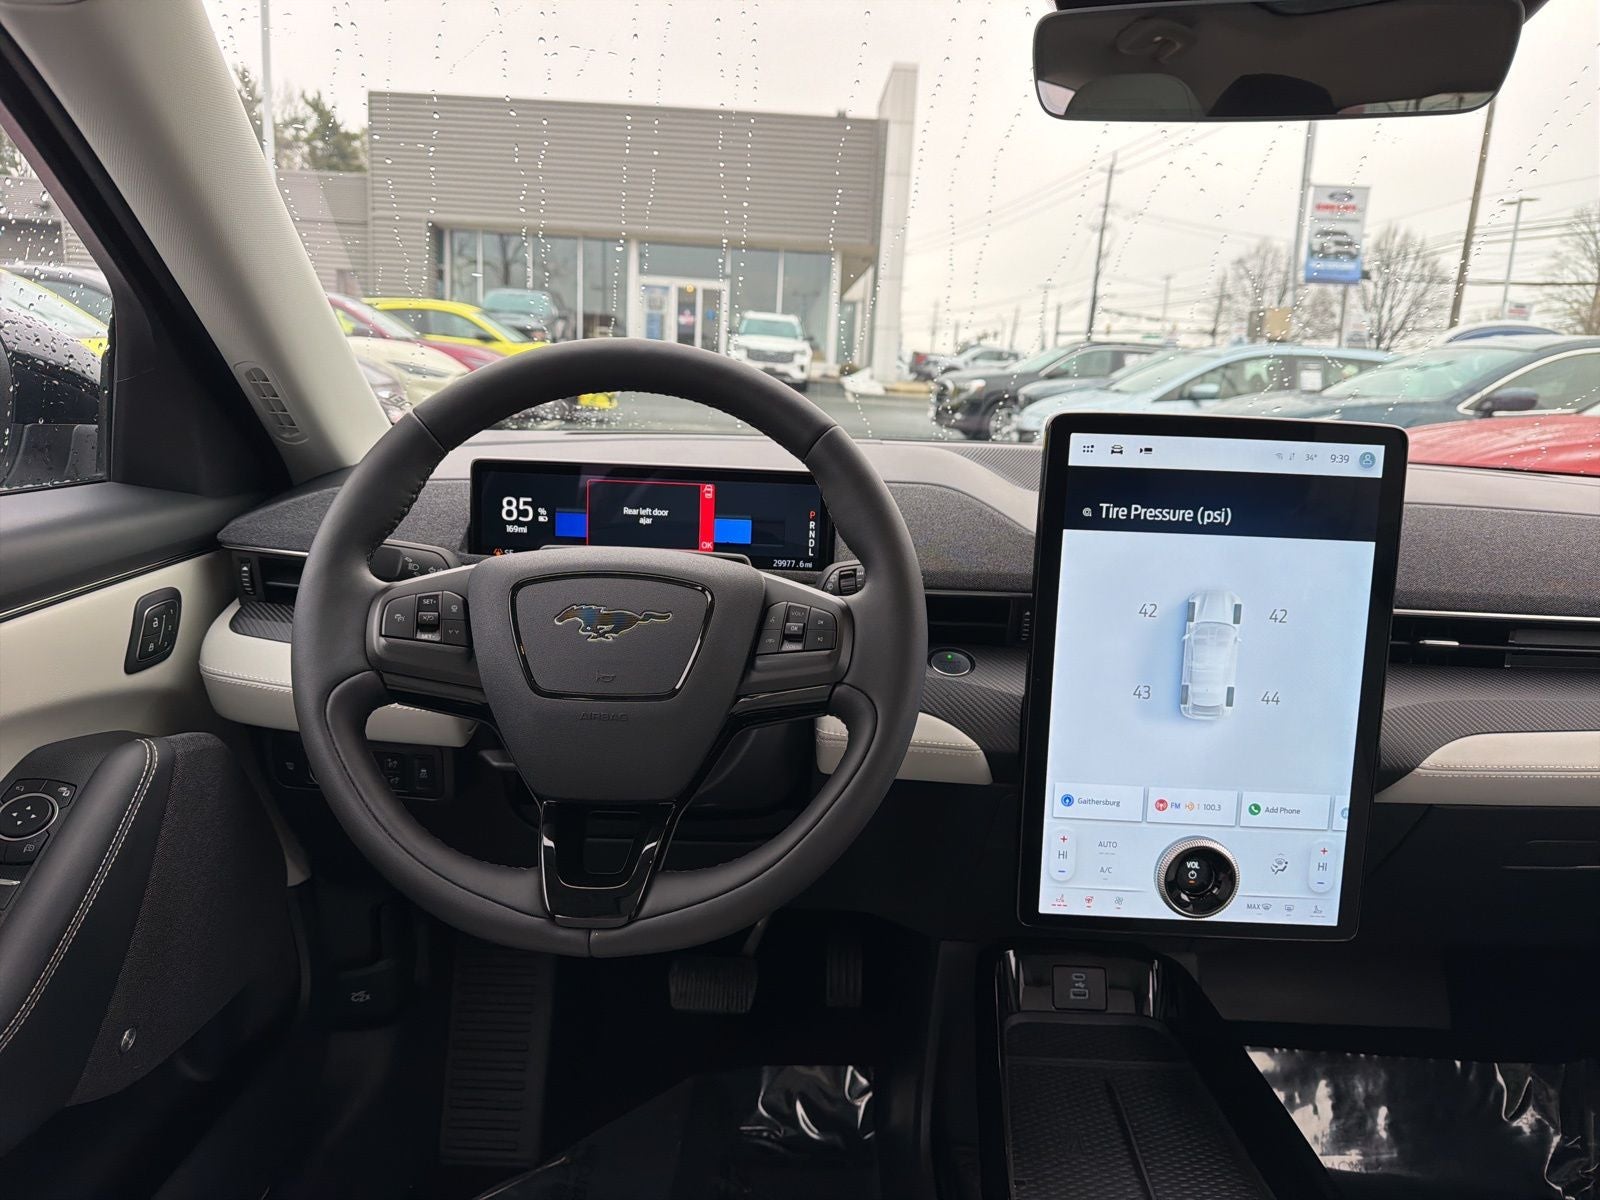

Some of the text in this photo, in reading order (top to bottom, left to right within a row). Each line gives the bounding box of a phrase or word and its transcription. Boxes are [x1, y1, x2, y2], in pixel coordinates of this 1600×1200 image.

[1330, 454, 1350, 464] 9:39
[502, 497, 534, 522] 85
[538, 507, 547, 515] %
[623, 507, 669, 516] Rear left door
[1100, 503, 1232, 526] Tire Pressure (psi)
[639, 517, 652, 525] ajar
[1138, 603, 1157, 618] 42
[1269, 609, 1288, 623] 42
[1133, 685, 1151, 699] 43
[1261, 691, 1280, 705] 44
[1077, 797, 1121, 807] Gaithersburg
[1203, 803, 1222, 811] 100.3
[1186, 861, 1200, 869] VOL
